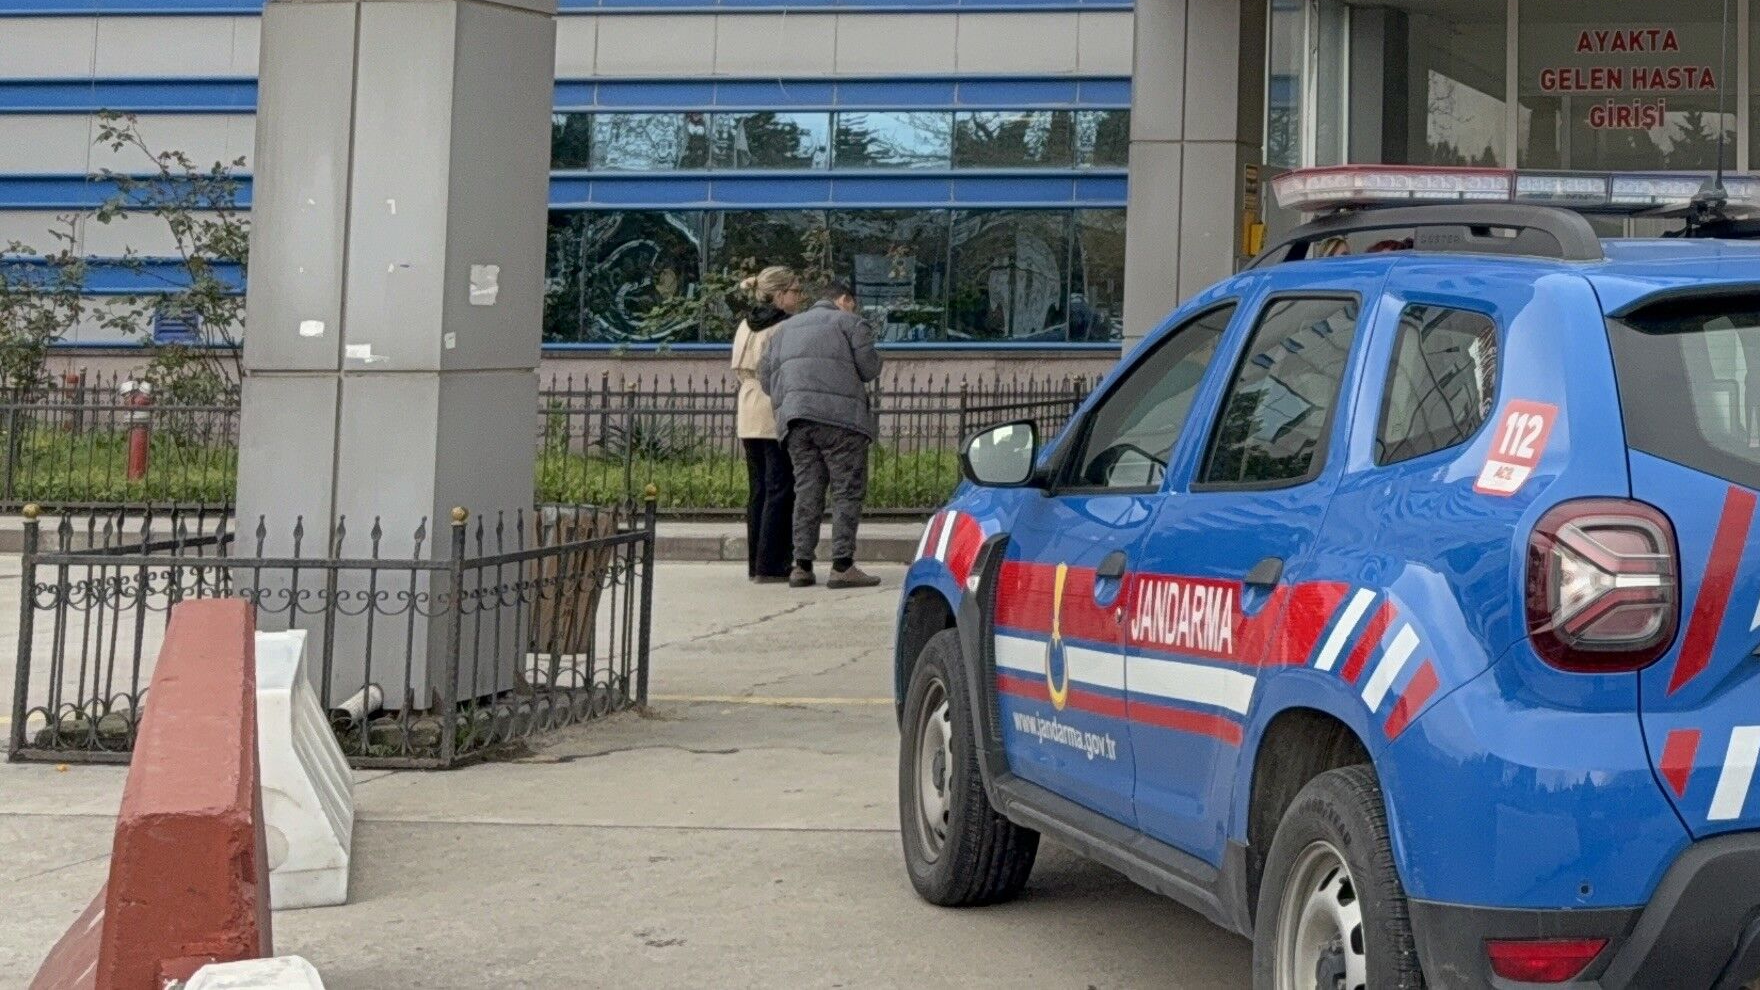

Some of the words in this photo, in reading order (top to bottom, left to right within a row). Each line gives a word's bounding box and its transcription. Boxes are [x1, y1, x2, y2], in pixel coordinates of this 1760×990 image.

[1576, 29, 1679, 52] AYAKTA
[1540, 67, 1622, 91] GELEN
[1632, 66, 1716, 90] HASTA
[1589, 98, 1666, 130] GİRİŞİ
[1499, 412, 1543, 459] 112
[1131, 579, 1233, 654] JANDARMA
[1012, 710, 1117, 761] www.jandarma.gov.tr
